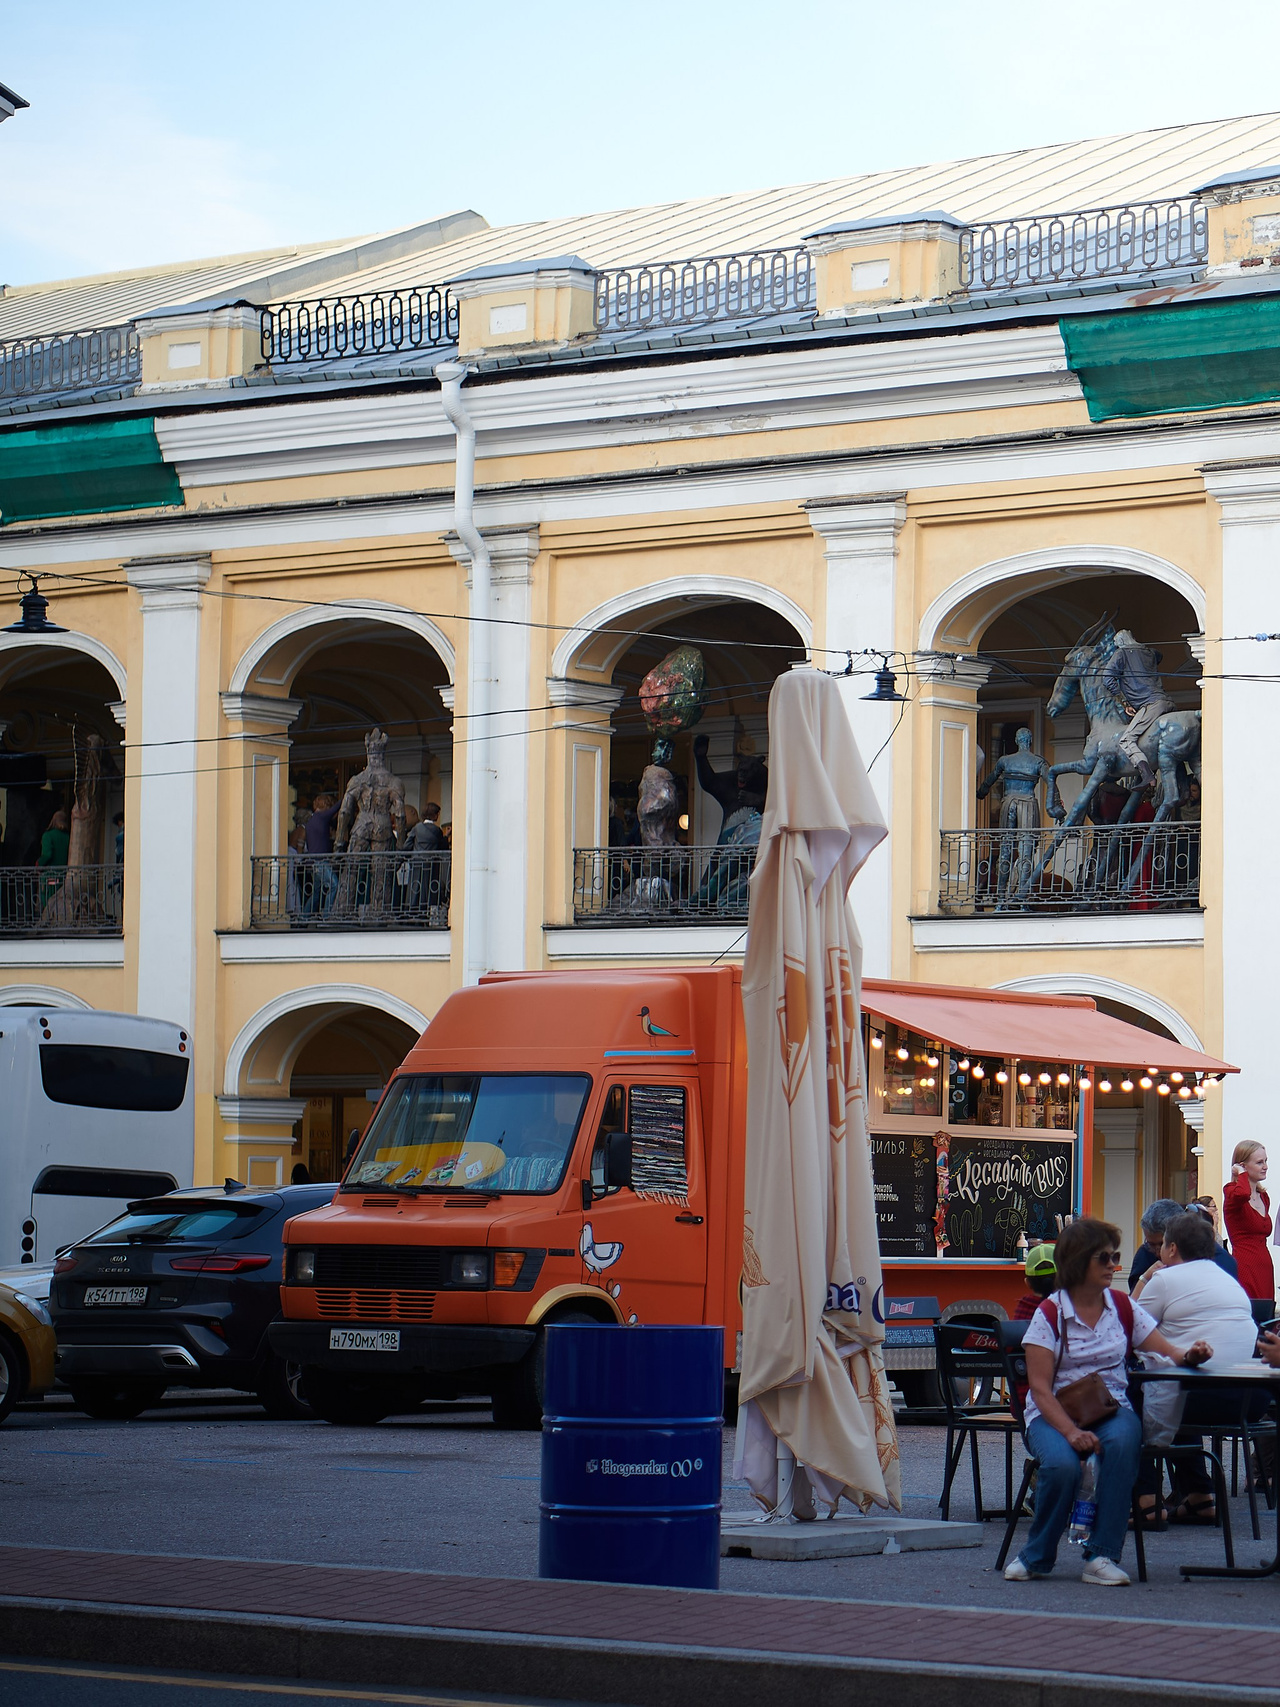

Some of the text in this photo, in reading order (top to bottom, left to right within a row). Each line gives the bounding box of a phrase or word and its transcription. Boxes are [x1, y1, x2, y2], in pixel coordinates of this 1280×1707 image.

[870, 1139, 905, 1155] ДИЛЬЯ
[1036, 1156, 1066, 1193] BUS
[129, 1288, 145, 1298] 198
[379, 1332, 396, 1345] 198
[971, 1333, 999, 1347] Bu
[601, 1459, 669, 1478] Hoegaarden
